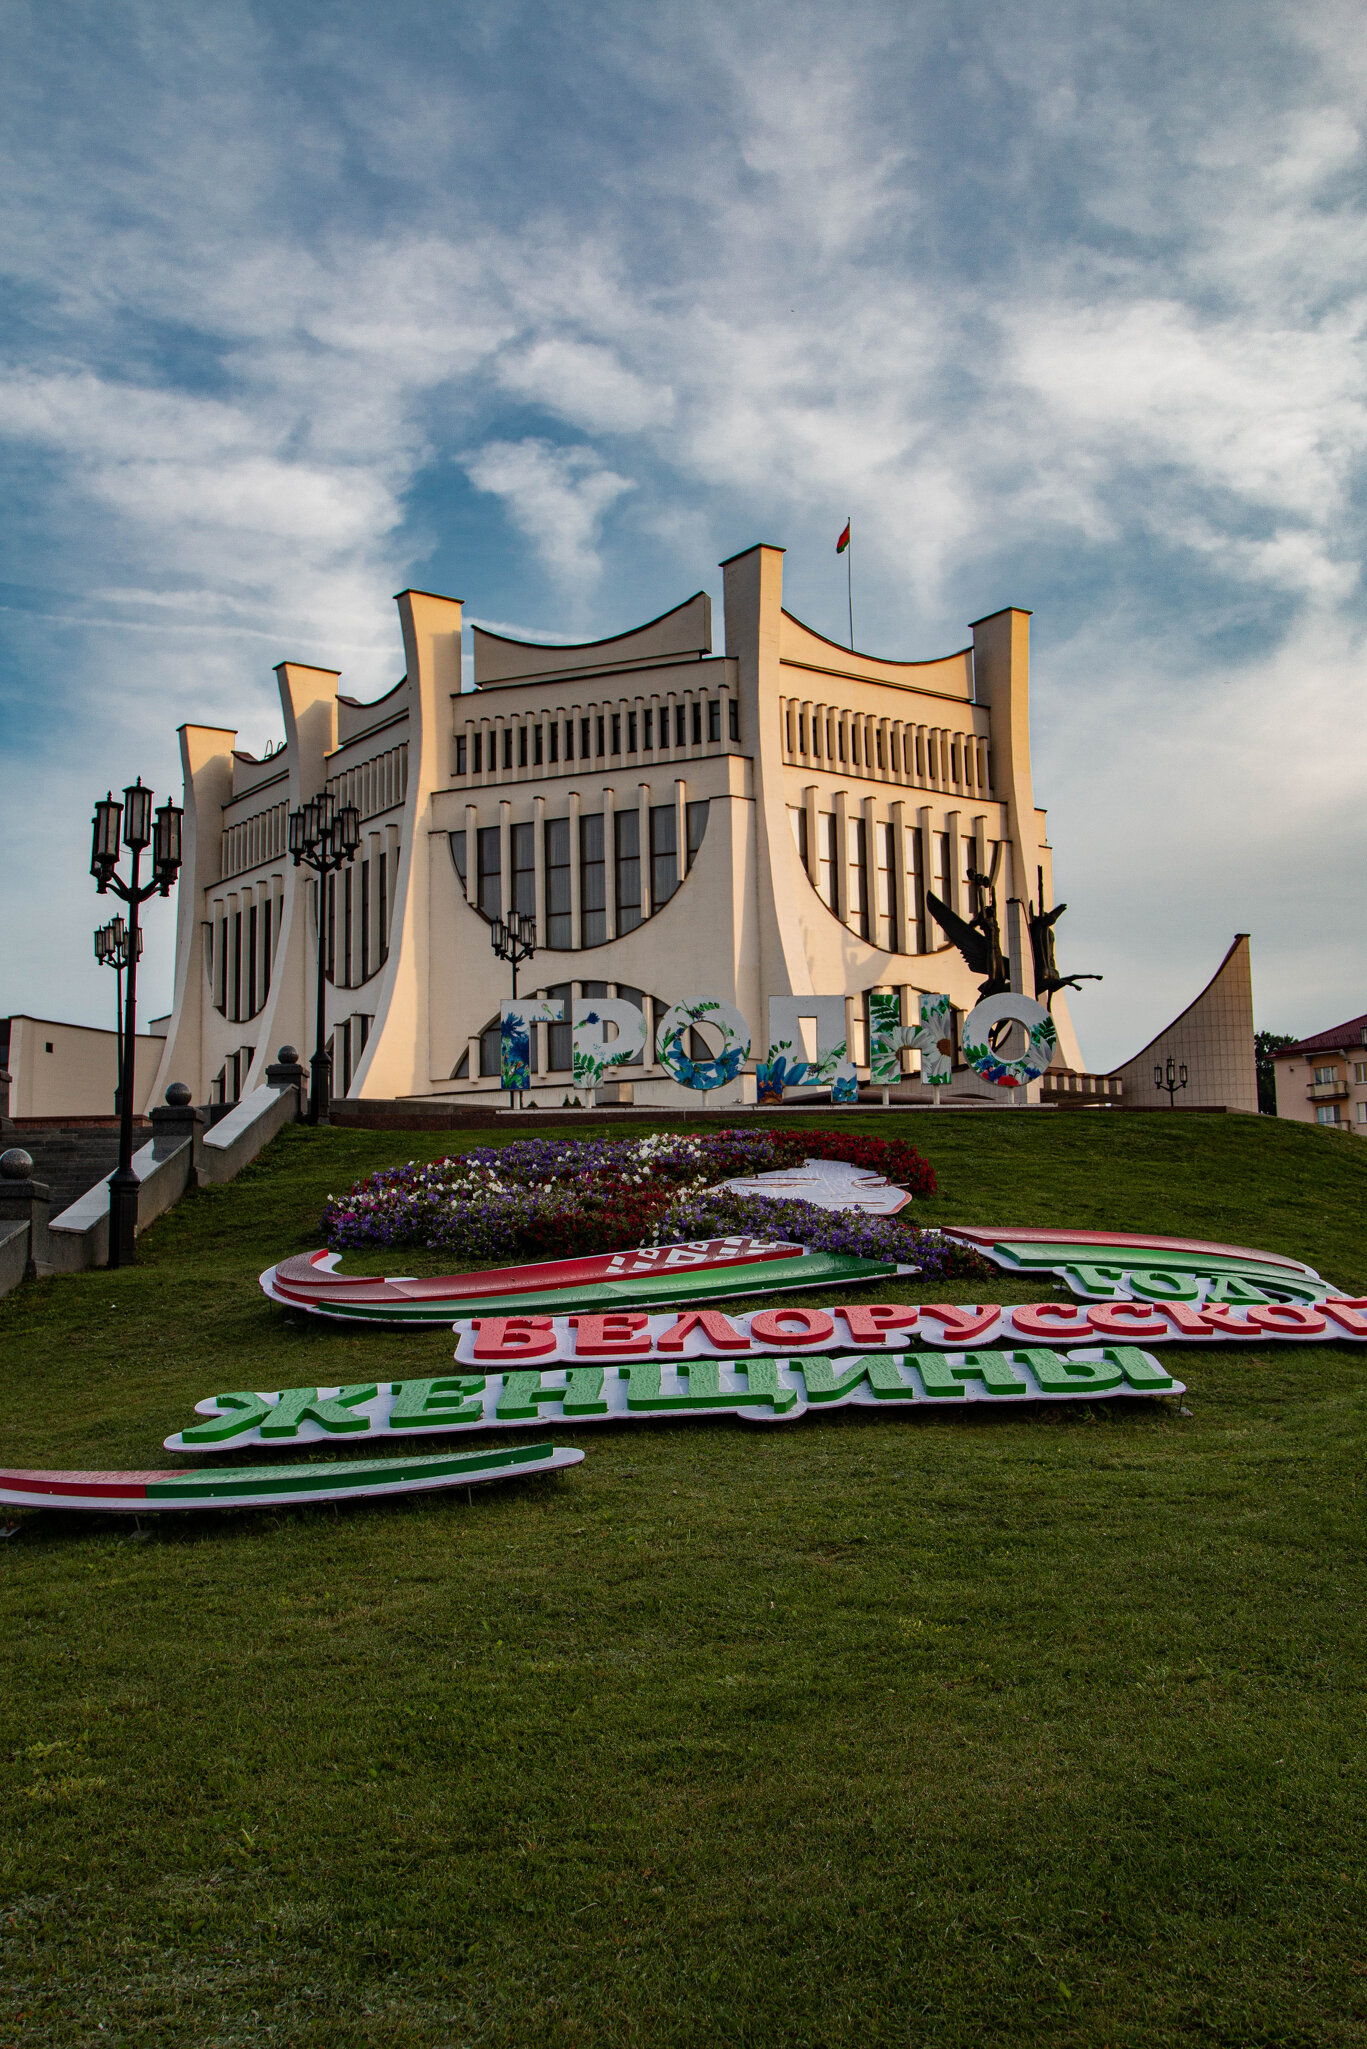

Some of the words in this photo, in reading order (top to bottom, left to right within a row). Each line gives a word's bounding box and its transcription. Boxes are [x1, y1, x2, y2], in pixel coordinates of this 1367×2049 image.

[501, 993, 1057, 1102] ГРОДНО
[1066, 1263, 1300, 1306] ГОД
[181, 1346, 1173, 1444] ЖЕНЩИНЫ
